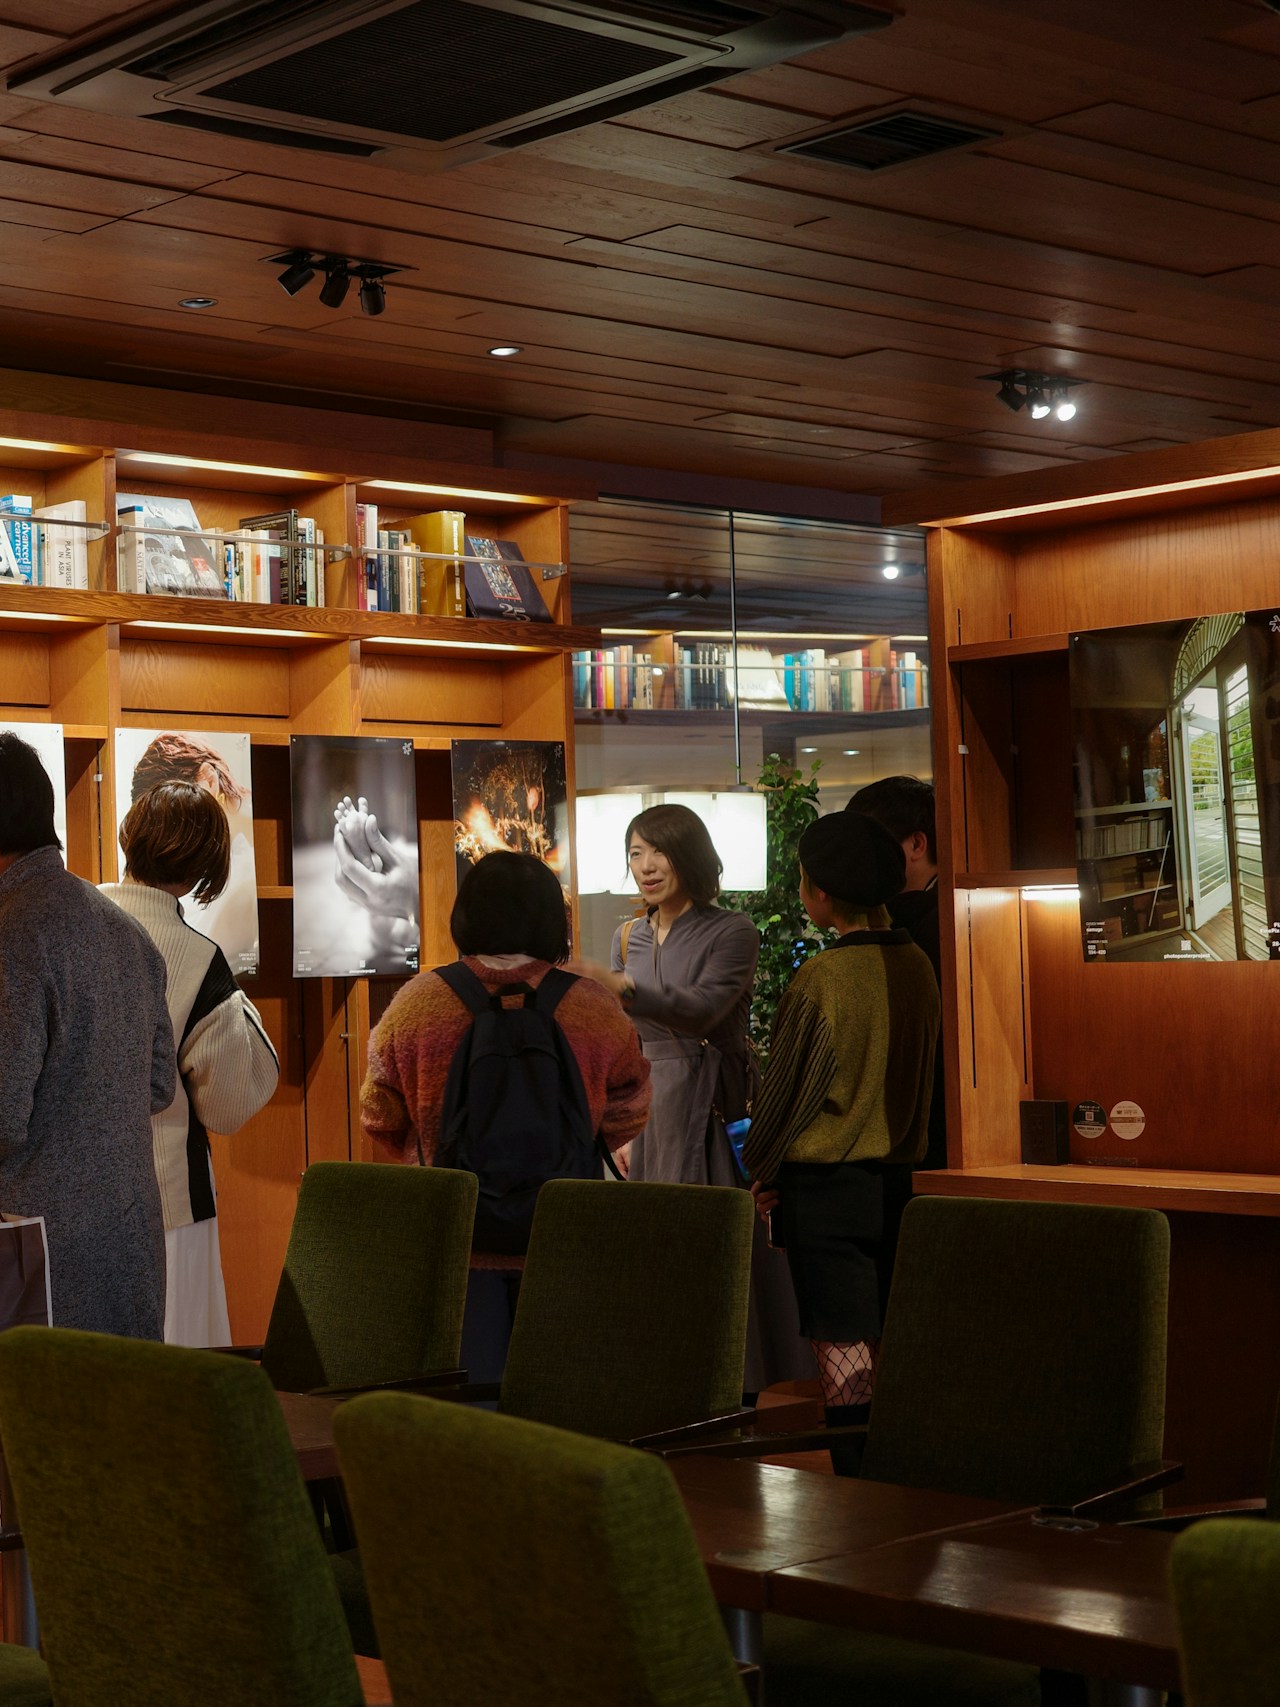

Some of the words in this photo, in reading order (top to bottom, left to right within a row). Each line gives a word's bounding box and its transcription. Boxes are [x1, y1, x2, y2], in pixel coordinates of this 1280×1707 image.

[21, 520, 31, 565] dvanced
[137, 552, 145, 584] MATLAB
[499, 603, 531, 622] 25
